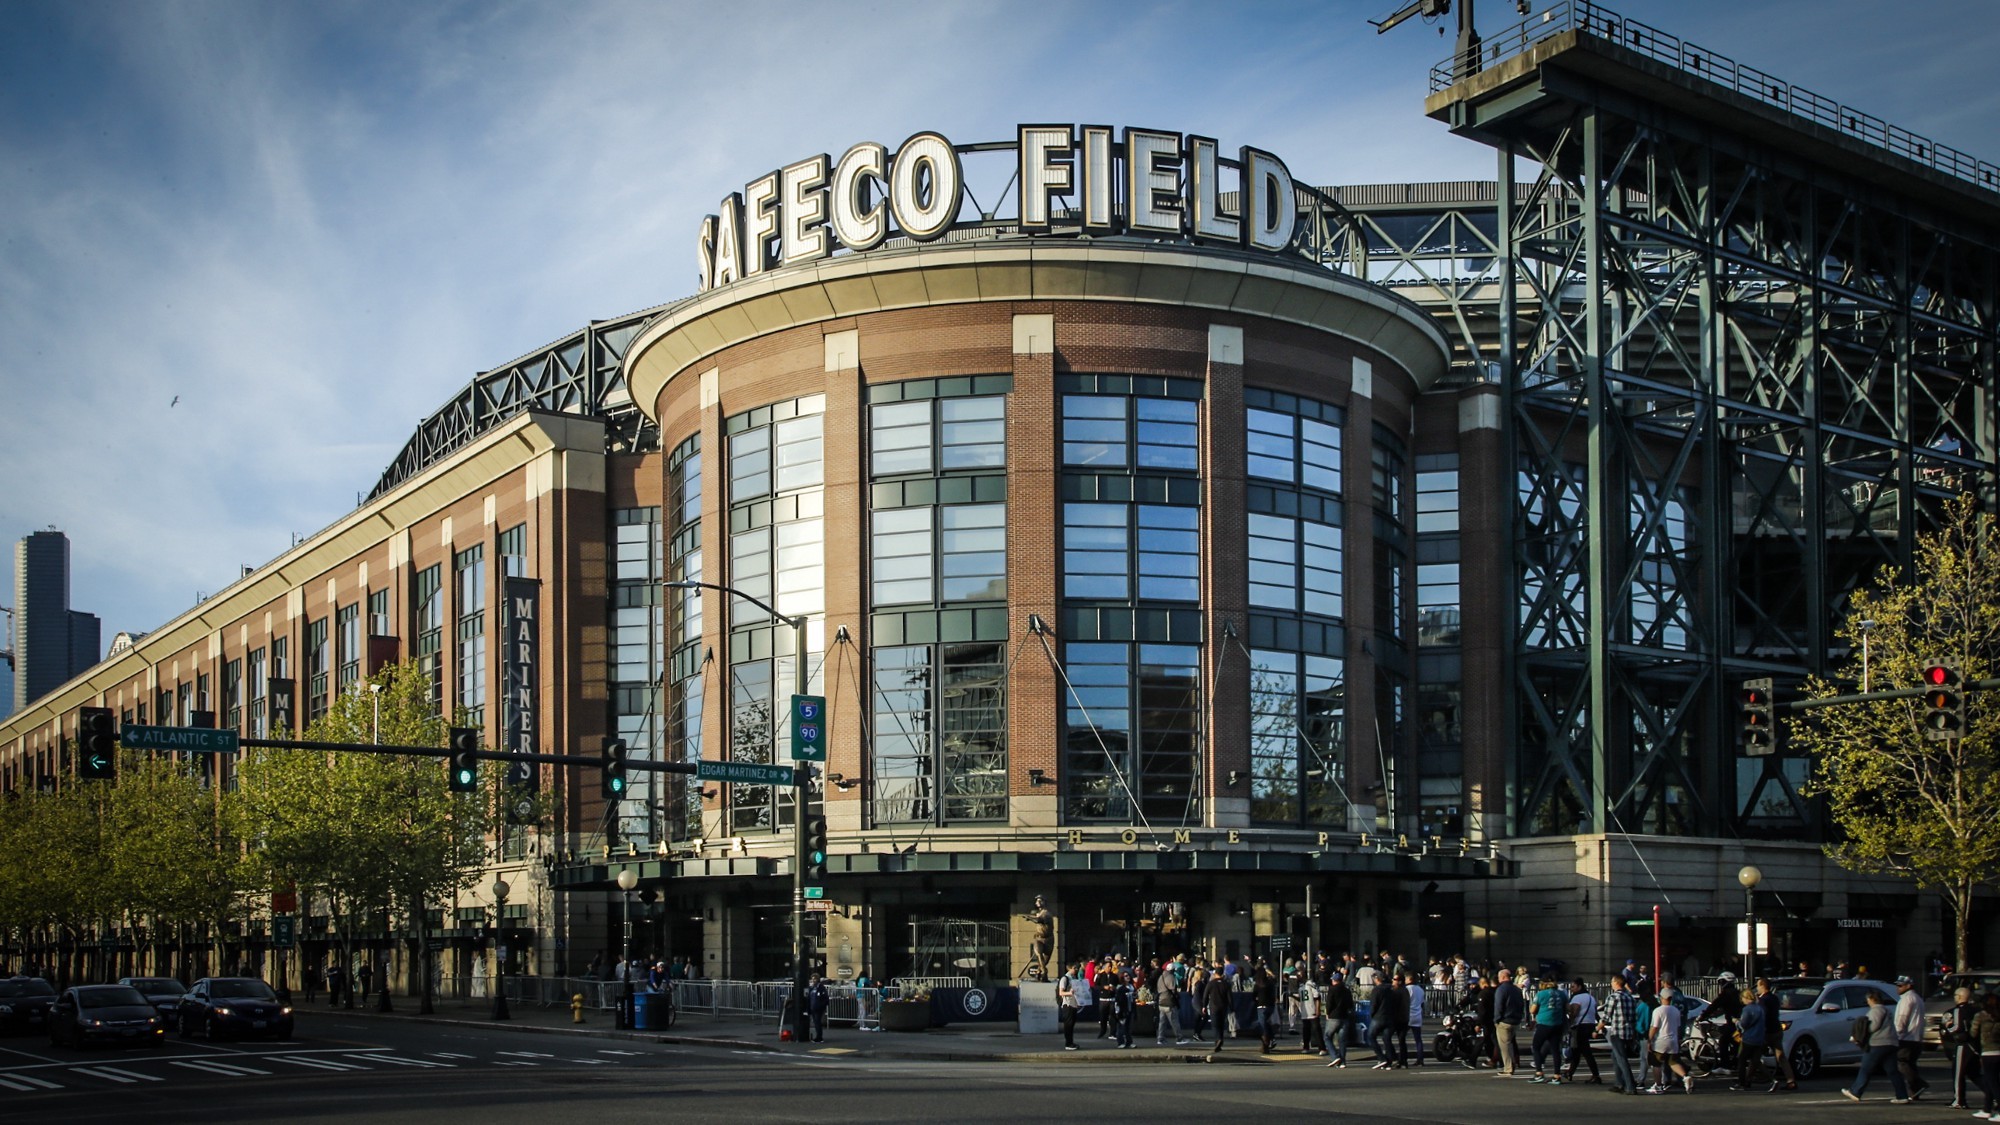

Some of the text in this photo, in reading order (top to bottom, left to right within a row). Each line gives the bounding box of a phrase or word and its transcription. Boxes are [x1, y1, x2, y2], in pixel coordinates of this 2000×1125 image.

[697, 123, 1298, 292] SAFECO FIELD
[515, 597, 534, 779] MARINERS
[805, 706, 812, 717] 5
[143, 730, 230, 746] ATLANTIC ST
[802, 728, 816, 737] 90
[701, 764, 726, 776] EDGAR
[728, 766, 767, 779] MARTINEZ
[603, 837, 746, 858] PLATE
[1068, 829, 1470, 851] HOME PLATE
[1837, 919, 1883, 928] MEDIA ENTRY
